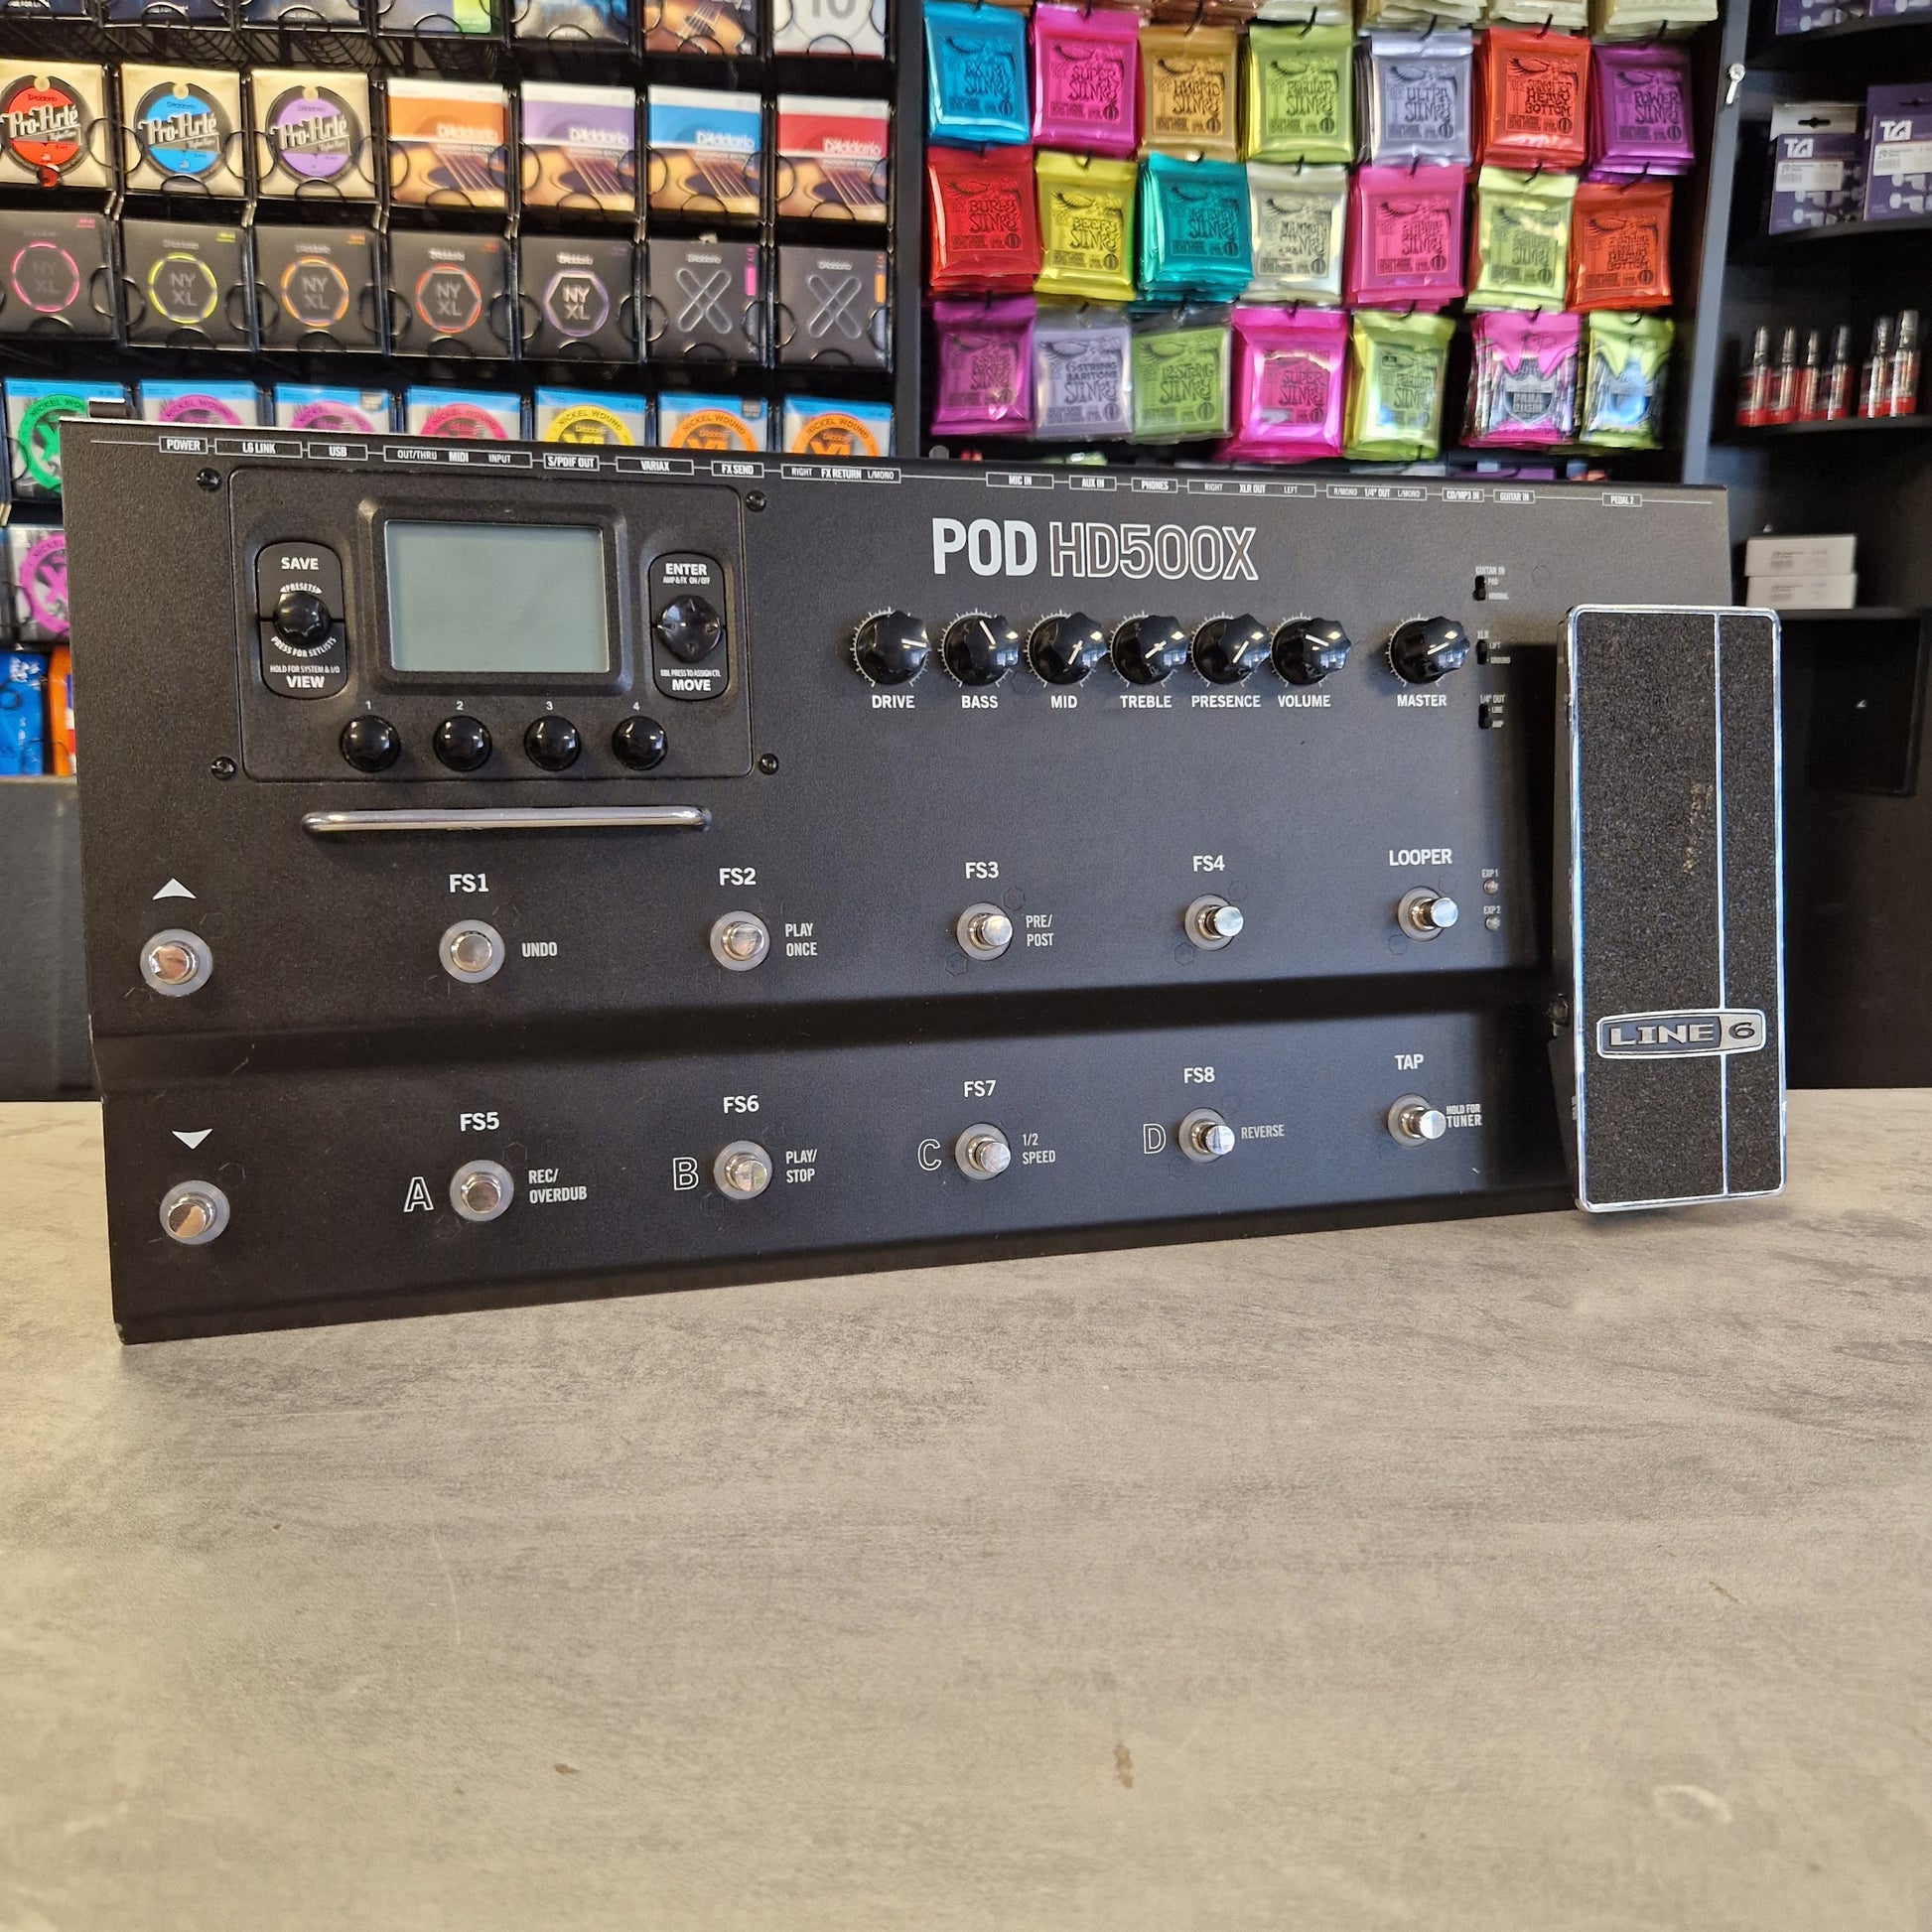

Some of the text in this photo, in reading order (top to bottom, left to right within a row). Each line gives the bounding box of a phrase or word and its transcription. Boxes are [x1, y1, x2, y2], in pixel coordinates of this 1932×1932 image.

[1071, 65, 1118, 82] SUPER
[1068, 79, 1121, 102] SLINKY
[1406, 87, 1449, 101] ULTRA
[1527, 91, 1572, 104] HEAVY
[1173, 95, 1222, 115] SLINKY
[1634, 91, 1680, 106] POWER
[1404, 101, 1452, 122] SLINKY
[1525, 102, 1572, 116] BOTTOM
[1072, 216, 1119, 231] BEEFY
[1069, 229, 1121, 252] SLINKY
[170, 272, 197, 288] NY
[301, 276, 329, 293] NY
[436, 281, 462, 298] NY
[562, 284, 591, 304] NY
[172, 290, 198, 307] XL
[305, 294, 331, 310] XL
[438, 300, 464, 317] XL
[564, 304, 591, 321] XL
[1066, 371, 1118, 381] BARITONE
[1282, 369, 1325, 385] SUPER
[1064, 380, 1119, 404] SLINKY
[1159, 378, 1213, 404] SLINKY
[432, 409, 462, 426] NICKEL
[558, 409, 623, 432] NICKEL WOUND
[682, 413, 746, 435] NICKEL WOUND
[805, 417, 870, 440] NICKEL WOUND
[166, 439, 202, 452] POWER
[242, 444, 276, 455] L6 LINK
[329, 446, 347, 457] USB
[397, 450, 511, 464] OUT/THRU MIDI INPUT
[547, 456, 596, 469] S/PDIF OUT
[640, 460, 670, 472] VARIAX
[721, 464, 755, 476] FX SEND
[791, 467, 895, 481] RIGHT FX RETURN L/MONO
[1008, 475, 1033, 486] MIC IN
[1081, 478, 1105, 488] AUX IN
[1141, 481, 1170, 490] PHONES
[1204, 483, 1298, 494] RIGHT XLR OUT LEFT
[1377, 488, 1391, 498] OUT
[1447, 490, 1480, 500] CD/MP3 IN
[1499, 491, 1530, 502] GUITAR IN
[1610, 494, 1635, 505] PEDAL 2
[932, 517, 1259, 581] POD HD500X
[281, 557, 320, 571] SAVE
[665, 563, 708, 576] ENTER
[285, 582, 317, 594] PRESETS
[270, 635, 338, 658] PRESS FOR SETLISTS
[269, 664, 287, 673] HOLD
[287, 665, 300, 674] FOR
[300, 665, 325, 674] SYSTEM
[285, 675, 326, 689] VIEW
[671, 679, 712, 692] MOVE
[365, 701, 372, 710] 1
[456, 701, 465, 711] 2
[545, 701, 554, 711] 3
[632, 701, 640, 711] 4
[872, 695, 915, 709] DRIVE
[961, 695, 999, 709] BASS
[1050, 695, 1078, 709] MID
[1120, 695, 1173, 709] TREBLE
[1191, 695, 1262, 708] PRESENCE
[1277, 695, 1331, 708] VOLUME
[1396, 694, 1448, 707] MASTER
[1192, 855, 1226, 872] FS4
[1388, 848, 1453, 866] LOOPER
[719, 867, 757, 887] FS2
[965, 861, 1000, 880] FS3
[449, 873, 489, 894] FS1
[1026, 913, 1053, 928] PRE/
[784, 922, 814, 938] PLAY
[1027, 933, 1054, 947] POST
[521, 941, 558, 958] UNDO
[785, 942, 818, 957] ONCE
[1609, 1022, 1755, 1046] LINE 6
[1394, 1053, 1425, 1070] TAP
[1183, 1066, 1216, 1084] FS8
[963, 1079, 997, 1097] FS7
[723, 1095, 759, 1114] FS6
[1446, 1103, 1482, 1115] HOLD FOR
[460, 1112, 500, 1131] FS5
[1446, 1114, 1483, 1129] TUNER
[1143, 1123, 1167, 1155] D
[1240, 1124, 1286, 1140] REVERSE
[1022, 1133, 1039, 1147] 1/2
[785, 1149, 818, 1166] PLAY/
[917, 1138, 942, 1172] C
[1022, 1150, 1056, 1165] SPEED
[528, 1168, 560, 1184] REC/
[672, 1156, 700, 1190] B
[785, 1168, 816, 1183] STOP
[403, 1175, 435, 1212] A
[528, 1184, 588, 1204] OVERDUB
